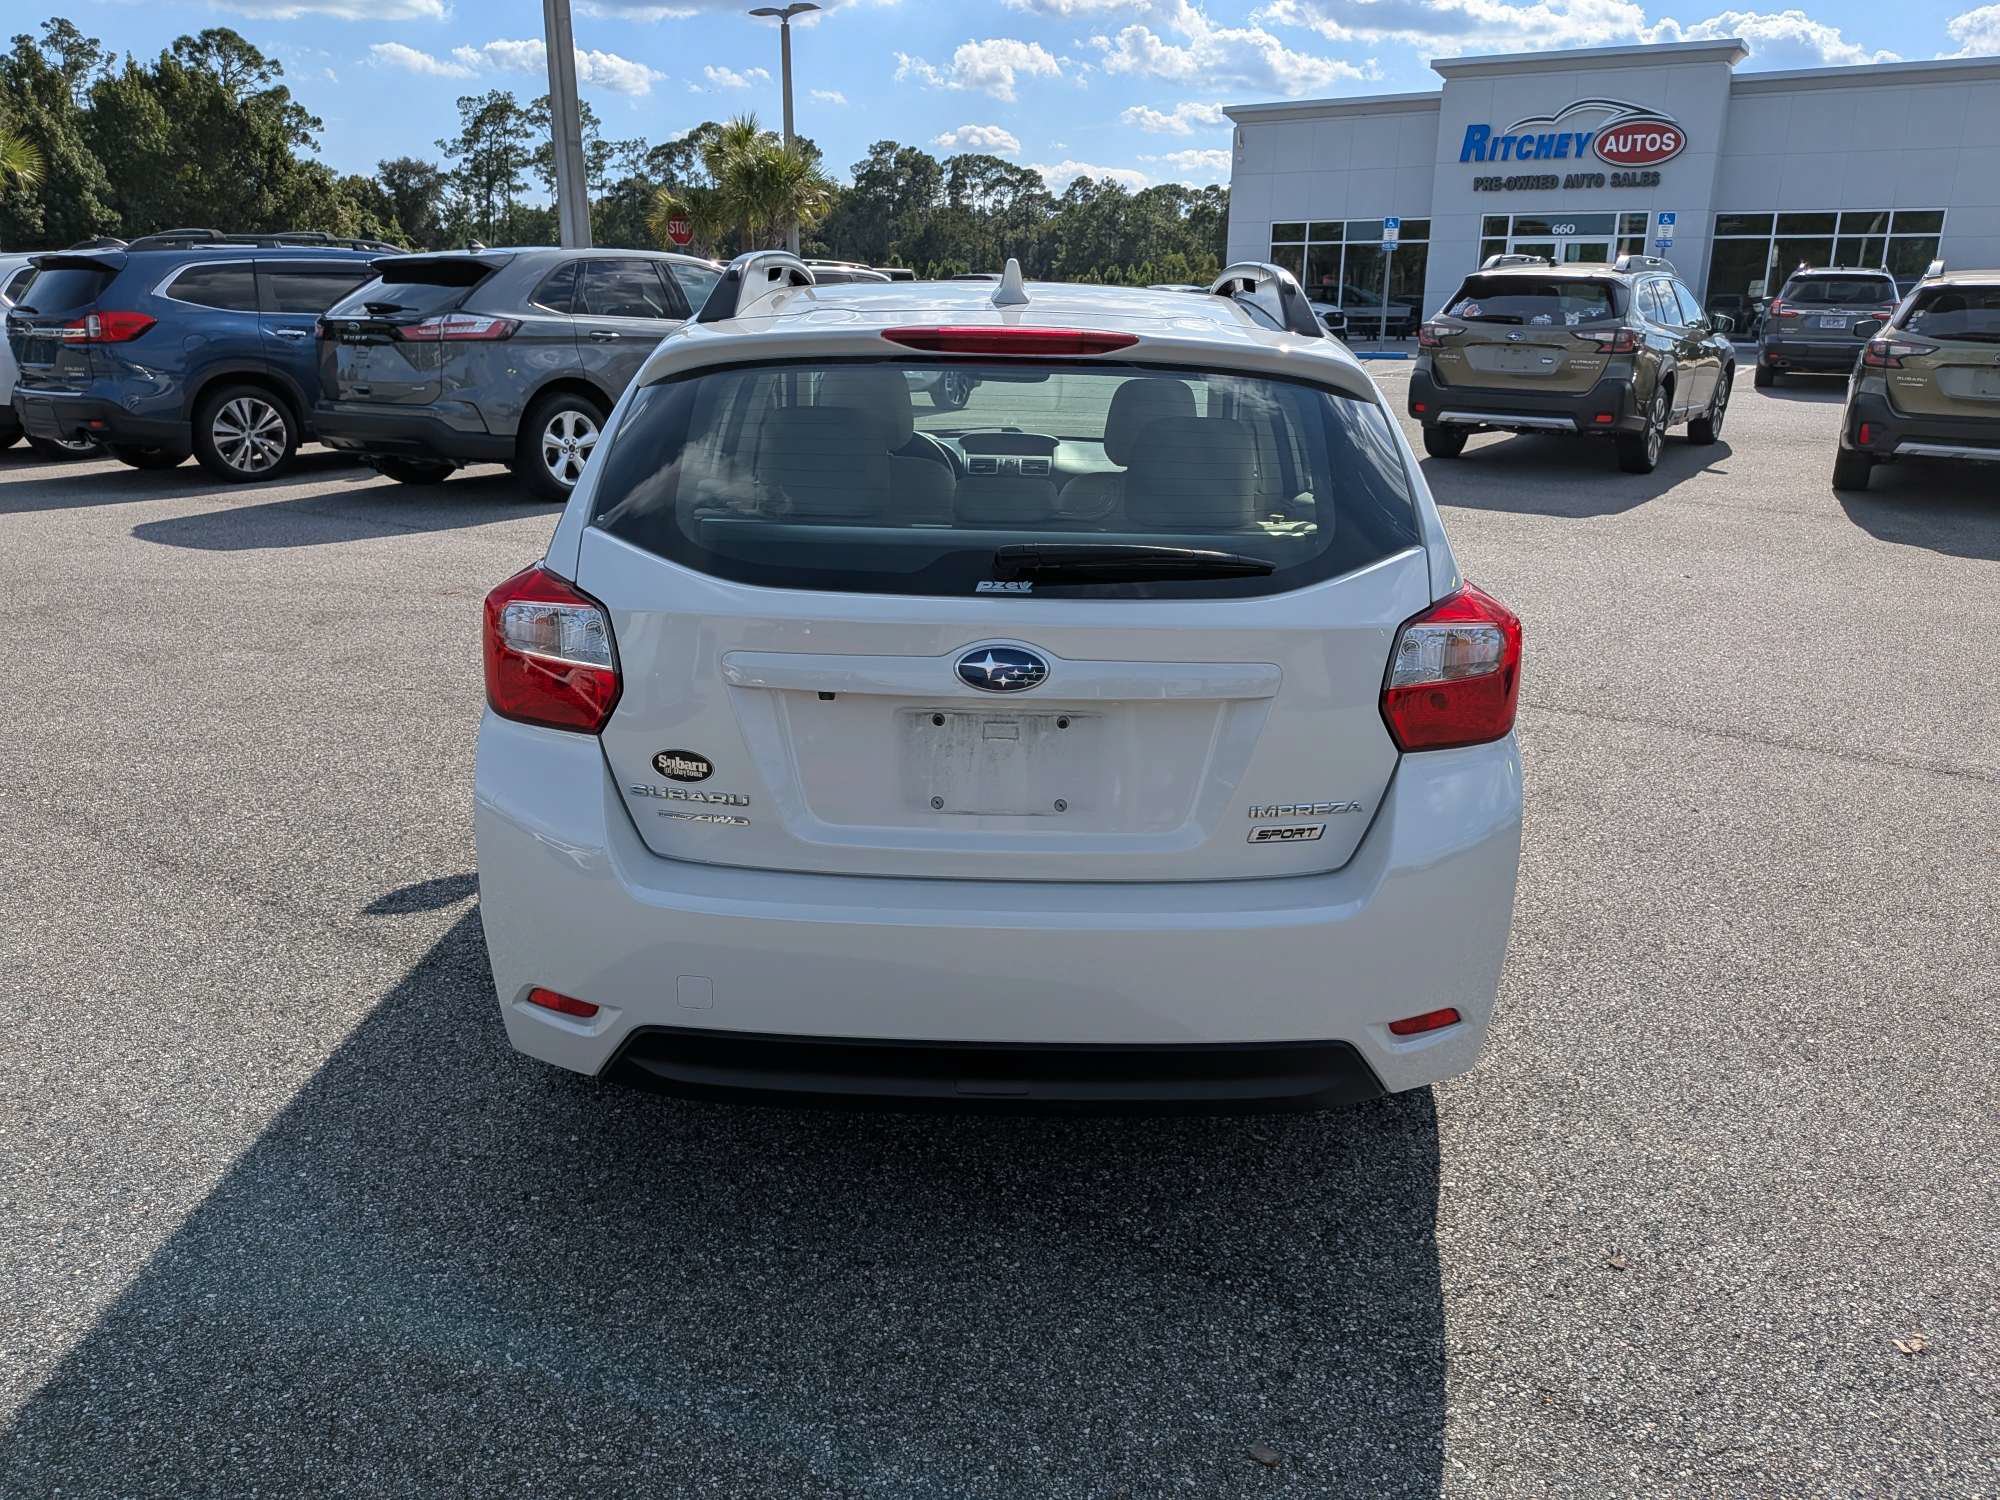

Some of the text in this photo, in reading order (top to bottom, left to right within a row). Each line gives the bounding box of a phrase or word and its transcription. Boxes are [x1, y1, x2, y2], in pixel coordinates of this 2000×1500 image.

[1459, 124, 1676, 163] RITCHEY AUTOS
[1472, 171, 1661, 192] PRE-OWNED AUTO SALES
[669, 220, 692, 234] STOP
[1551, 223, 1576, 235] 660
[658, 754, 708, 772] Subaru
[630, 783, 750, 807] SUBARU
[1247, 800, 1363, 819] IMPREZA
[1255, 826, 1318, 840] SPORT
